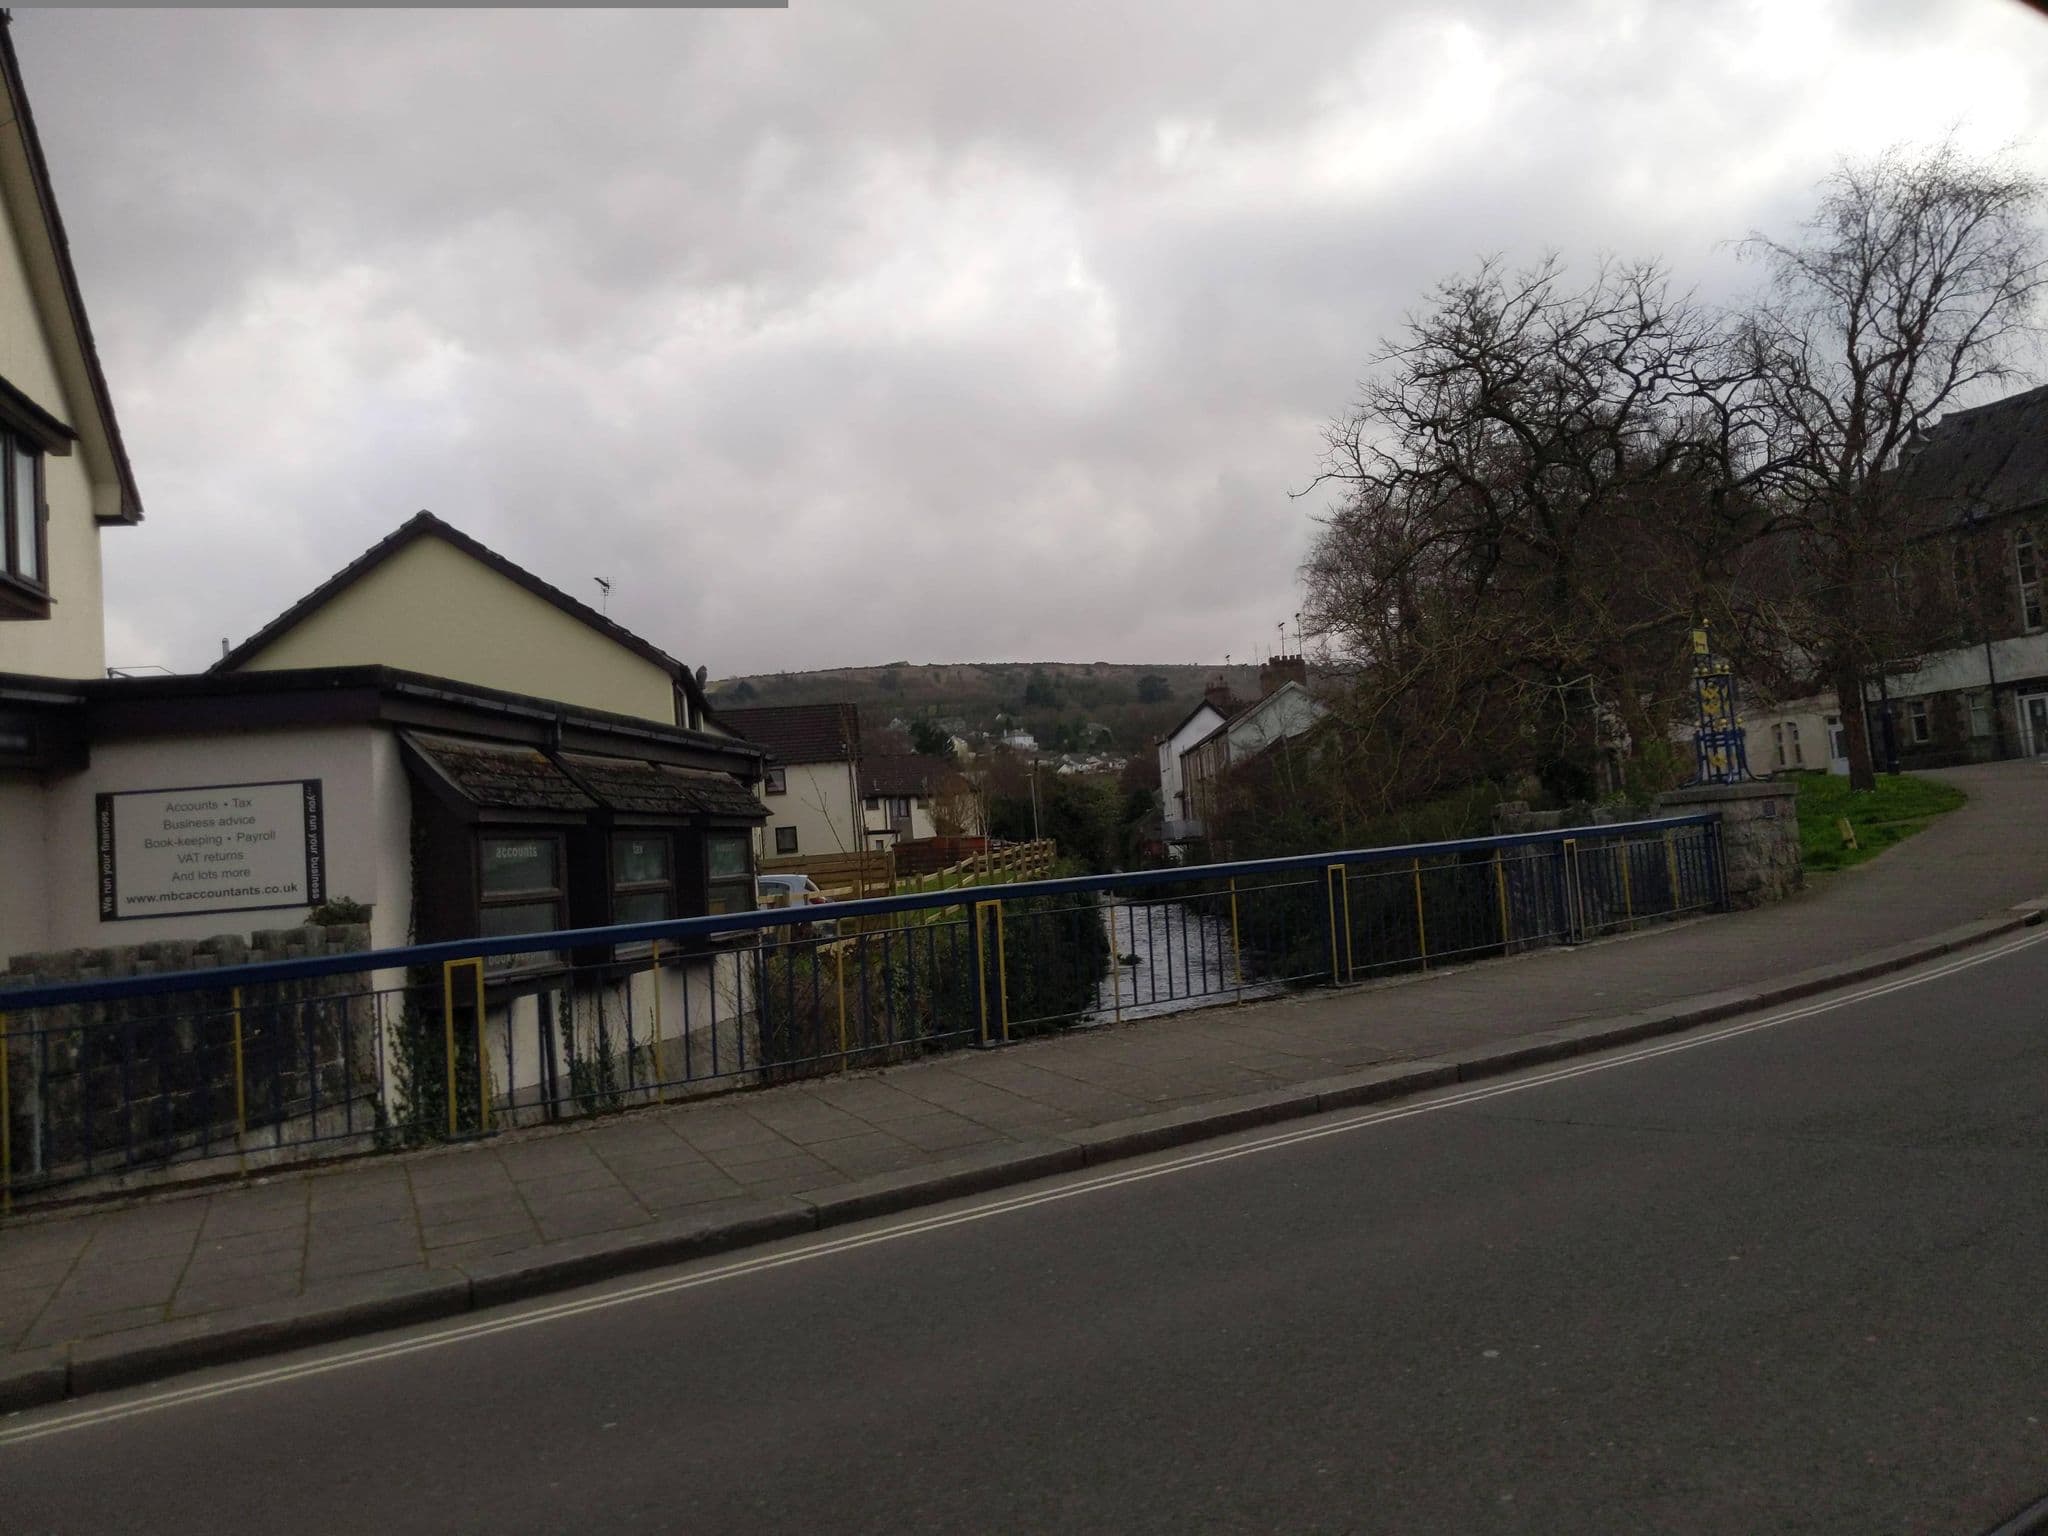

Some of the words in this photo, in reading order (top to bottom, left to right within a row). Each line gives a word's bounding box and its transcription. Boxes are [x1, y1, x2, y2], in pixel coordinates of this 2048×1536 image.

[166, 801, 218, 812] Accounts
[232, 798, 252, 808] Tax
[163, 819, 215, 830] Business
[218, 816, 256, 826] advice
[144, 834, 223, 848] Book-keeping
[237, 830, 276, 843] Payroll
[308, 833, 318, 854] your
[103, 854, 112, 875] your
[177, 852, 201, 863] VAT
[204, 851, 244, 862] returns
[171, 871, 194, 882] And
[198, 870, 218, 880] lots
[222, 868, 252, 878] more
[311, 856, 320, 899] business
[104, 879, 112, 894] run
[126, 882, 298, 904] www.mbcaccountants.co.uk
[103, 897, 112, 913] We
